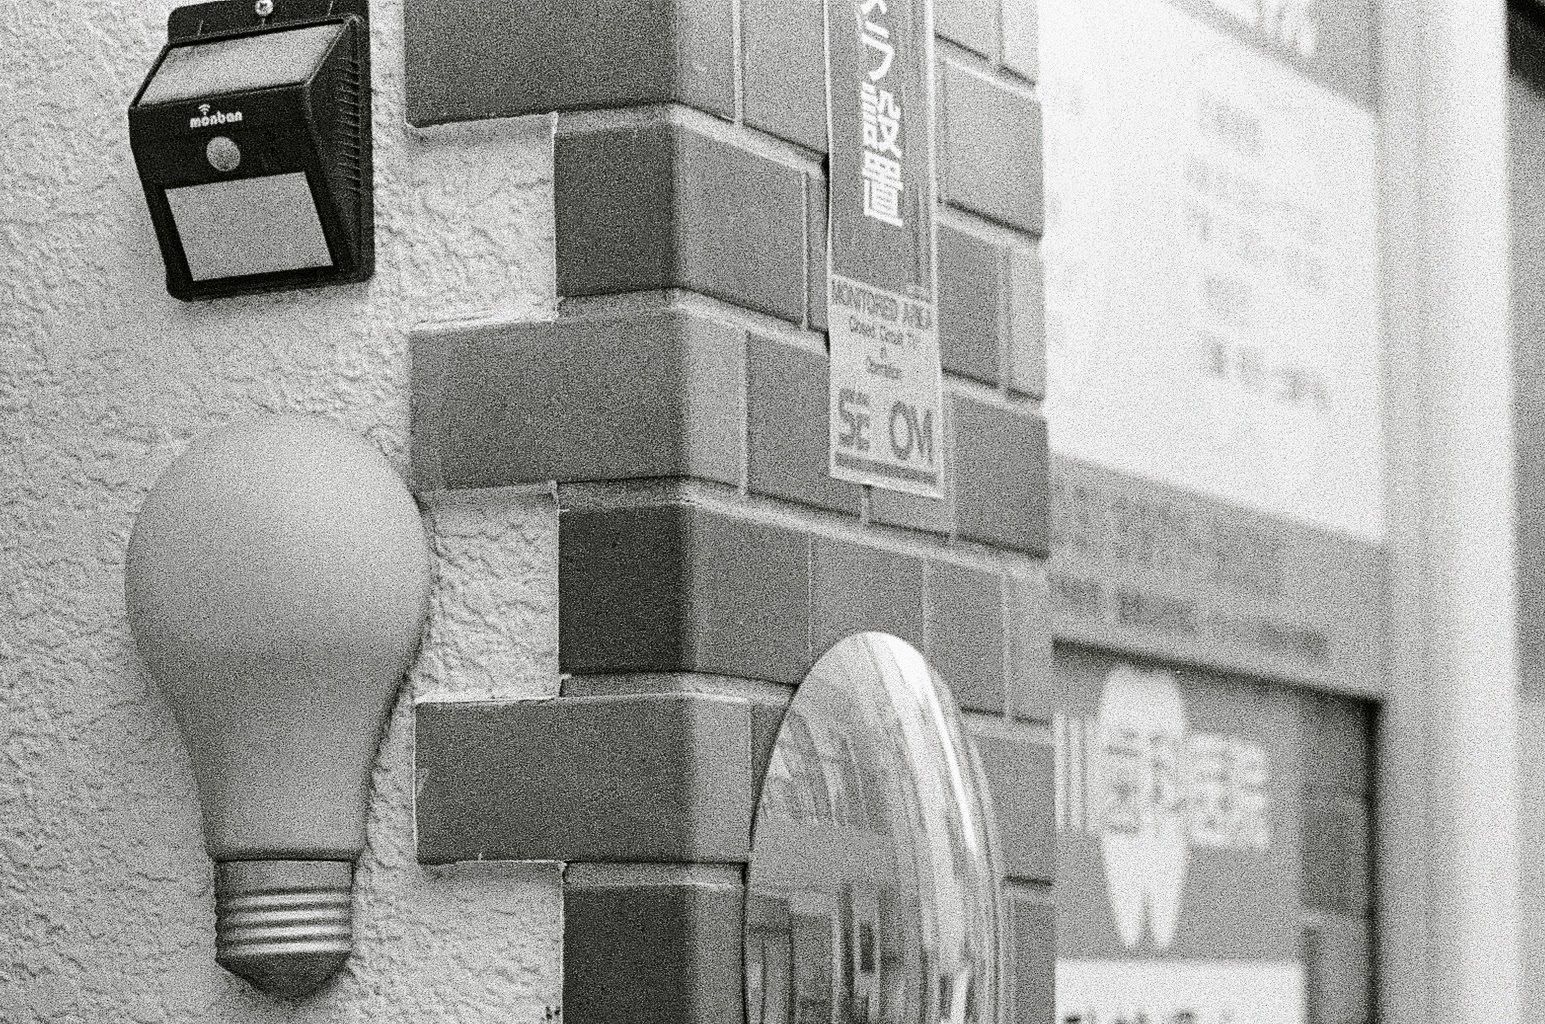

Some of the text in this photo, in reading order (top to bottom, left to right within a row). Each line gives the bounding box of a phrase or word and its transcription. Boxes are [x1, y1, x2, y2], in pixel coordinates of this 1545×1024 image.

[190, 110, 243, 128] monban
[860, 0, 904, 228] ラ設置
[831, 278, 932, 331] MONITORED AREA
